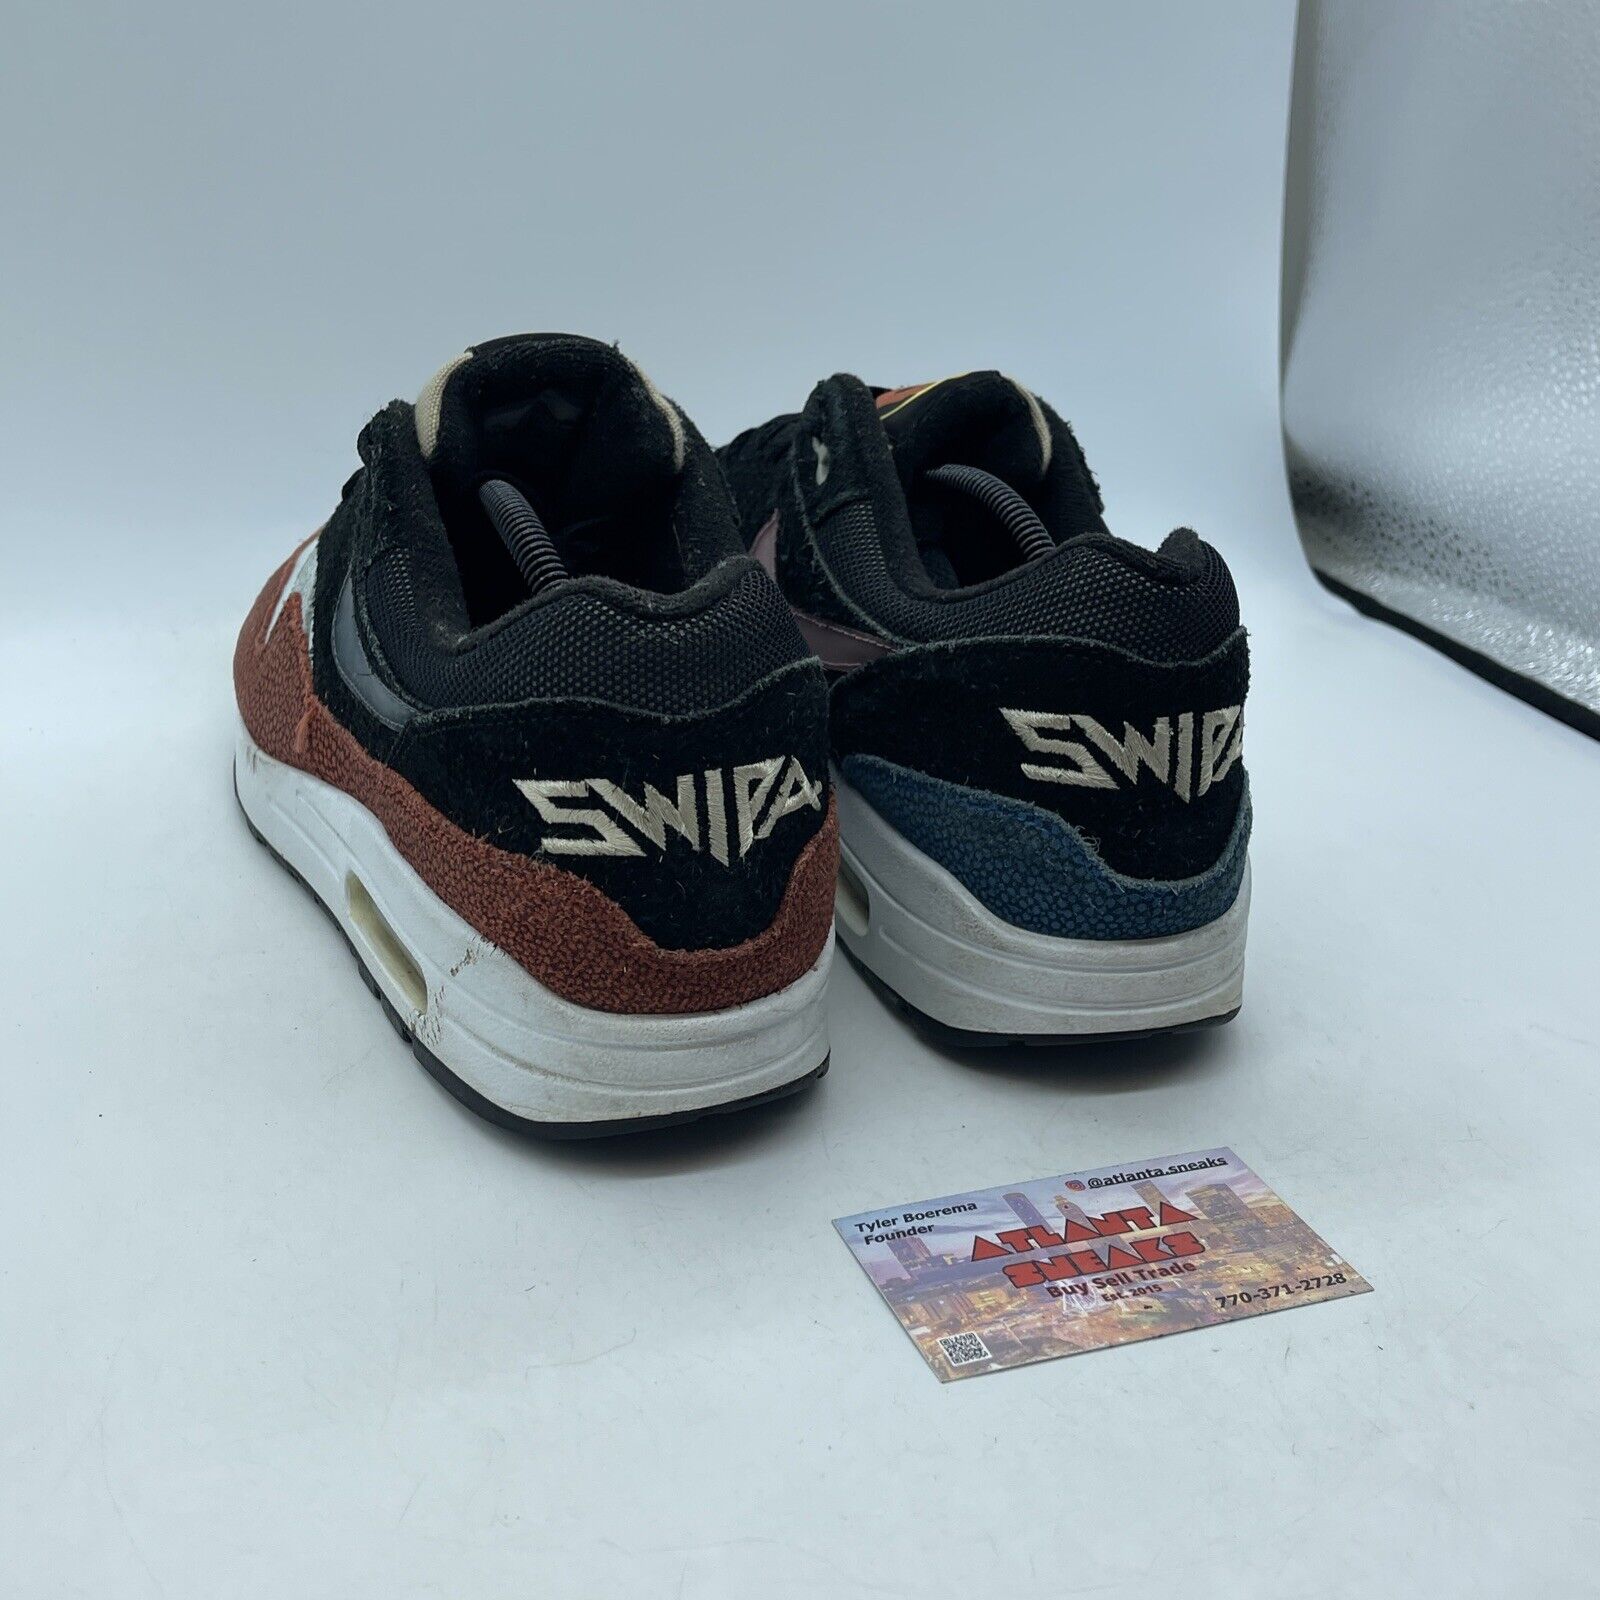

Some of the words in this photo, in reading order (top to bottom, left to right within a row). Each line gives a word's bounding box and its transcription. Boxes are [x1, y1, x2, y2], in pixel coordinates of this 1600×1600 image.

[512, 755, 823, 867] SWIPA
[1087, 1157, 1228, 1189] @atlanta.sneaks
[856, 1215, 899, 1234] Tyler
[903, 1202, 978, 1223] Boerema
[864, 1224, 935, 1245] Founder
[970, 1201, 1200, 1262] ATLANTA
[1002, 1231, 1206, 1289] SNEAKS
[1047, 1281, 1090, 1300] Buy
[1095, 1271, 1130, 1290] Sell
[1135, 1262, 1198, 1283] Trade
[1101, 1291, 1128, 1303] Est.
[1131, 1284, 1162, 1297] 2015
[1215, 1273, 1347, 1310] 770-371-2728
